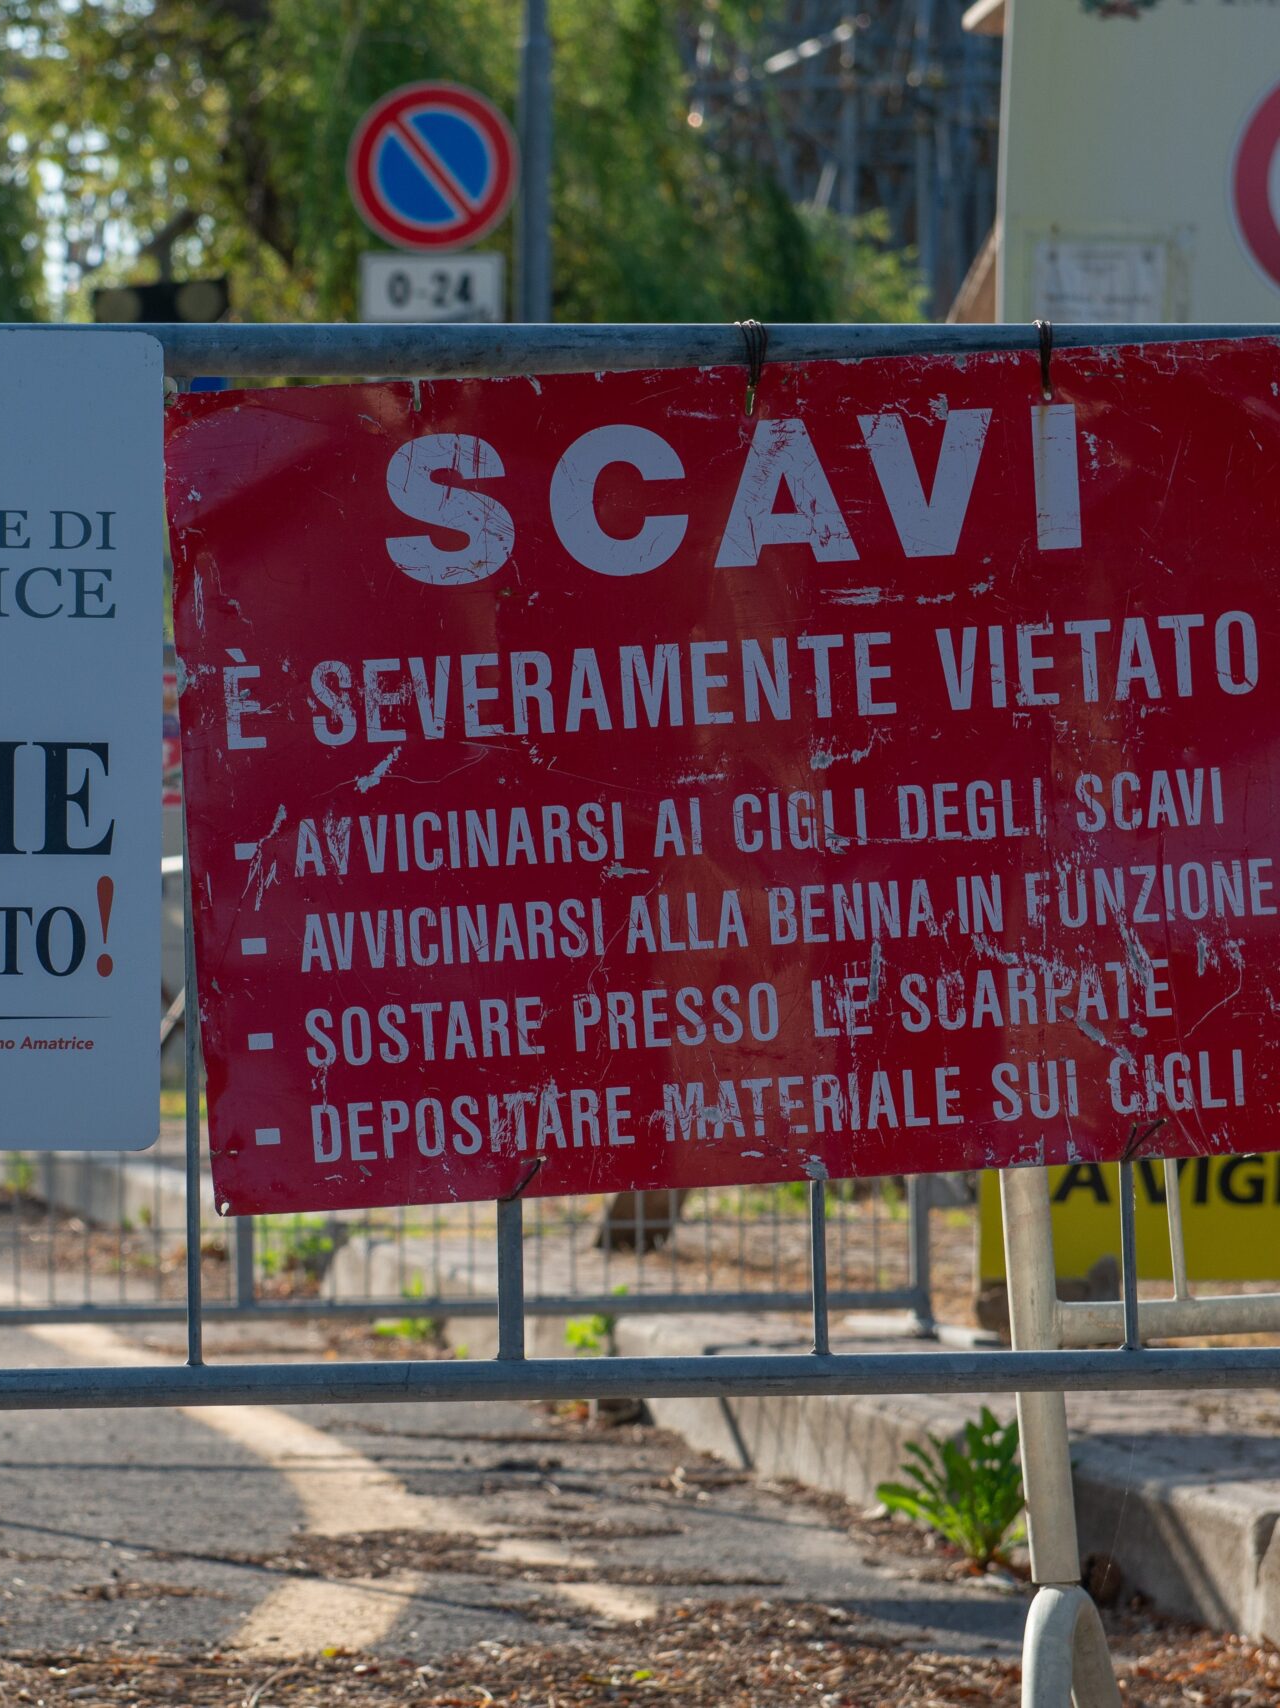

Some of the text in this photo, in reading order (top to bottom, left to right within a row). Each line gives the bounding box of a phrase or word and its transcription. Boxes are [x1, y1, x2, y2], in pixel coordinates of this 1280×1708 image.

[387, 271, 474, 308] 0-24
[50, 510, 117, 551] DI
[385, 403, 1083, 586] SCAVI
[223, 609, 1260, 751] È SEVERAMENTE VIETATO
[294, 801, 625, 878] AVVICINARSI
[653, 796, 703, 858] AI
[733, 787, 868, 853] CIGLI
[899, 776, 1043, 841] DEGLI
[1075, 766, 1225, 833] SCAVI
[300, 896, 605, 974] AVVICINARSI
[626, 888, 749, 955] ALLA
[767, 878, 936, 946] BENNA
[957, 873, 1005, 935] IN
[1024, 857, 1279, 930] FUNZIONE
[19, 1035, 95, 1051] Amatrice
[304, 995, 547, 1068] SOSTARE
[572, 981, 780, 1053] PRESSO
[811, 974, 874, 1038] LE
[899, 958, 1174, 1034] SCARPATE
[310, 1085, 636, 1164] DEPOSITARE
[662, 1065, 965, 1143] MATERIALE
[991, 1058, 1079, 1122] SUI
[1108, 1048, 1246, 1115] CIGLI
[1137, 1155, 1280, 1206] VIG
